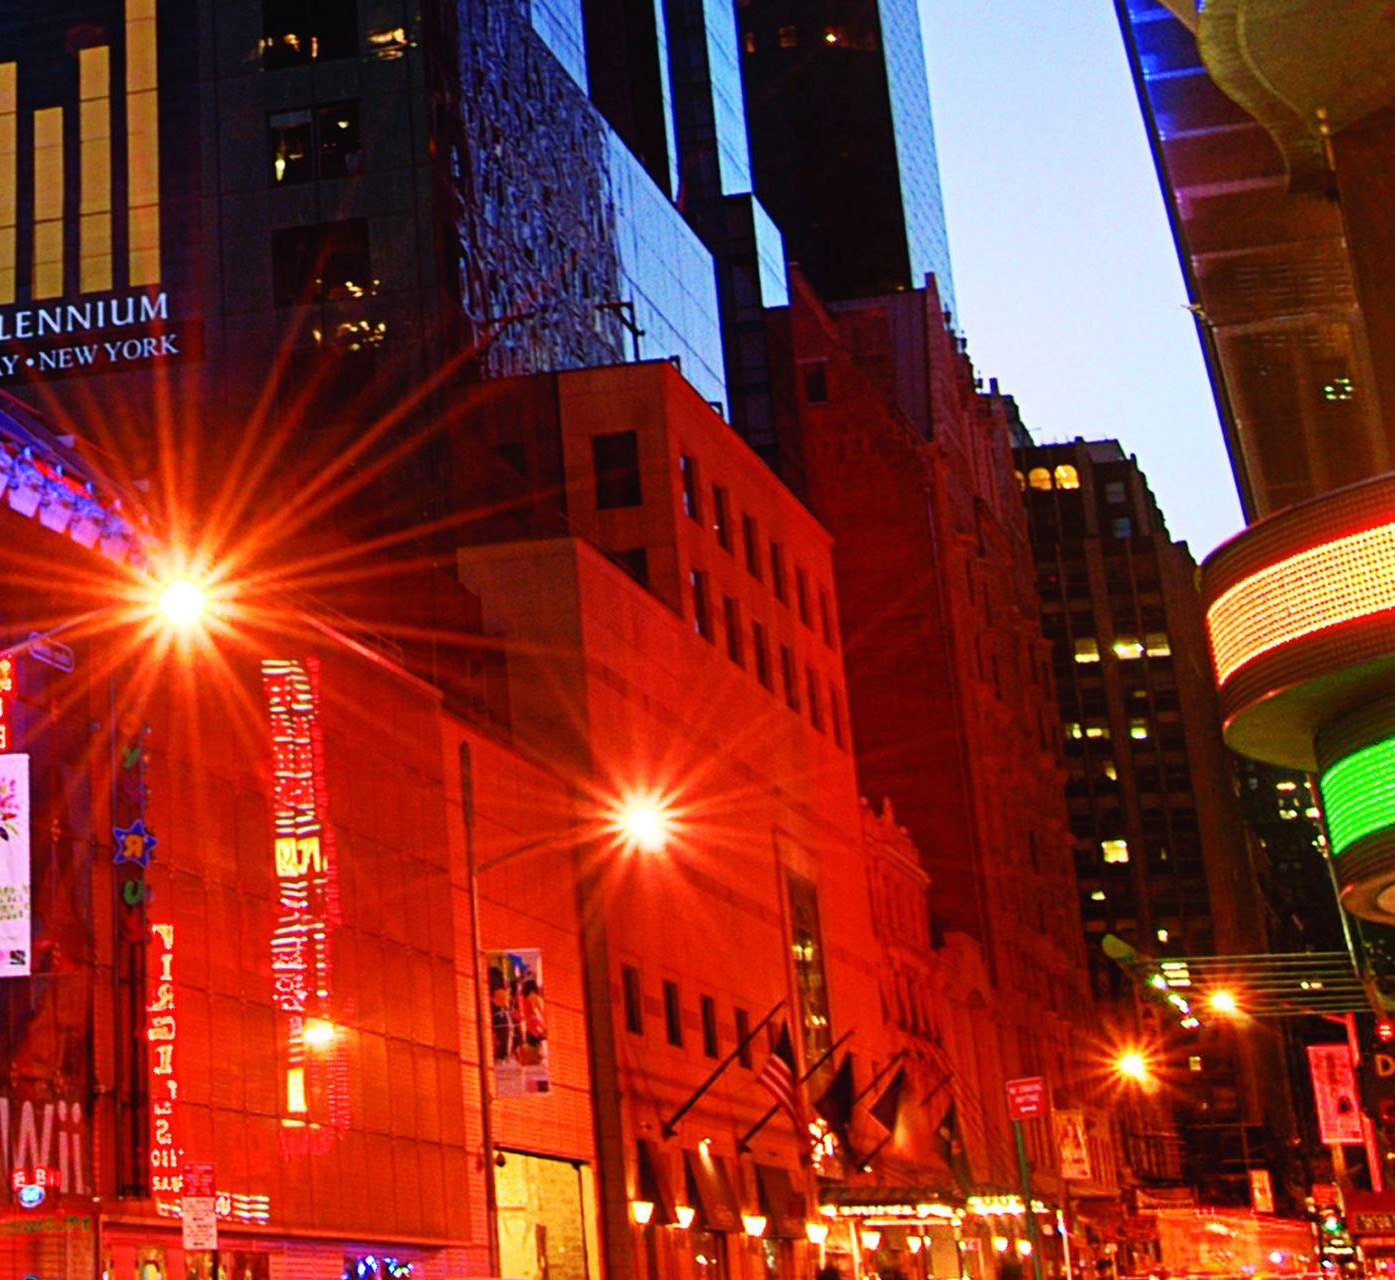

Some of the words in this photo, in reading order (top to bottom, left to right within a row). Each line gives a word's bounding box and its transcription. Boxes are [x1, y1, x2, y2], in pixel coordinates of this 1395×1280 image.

[38, 344, 99, 371] NEW
[104, 333, 180, 361] YORK
[0, 1096, 85, 1196] Wii
